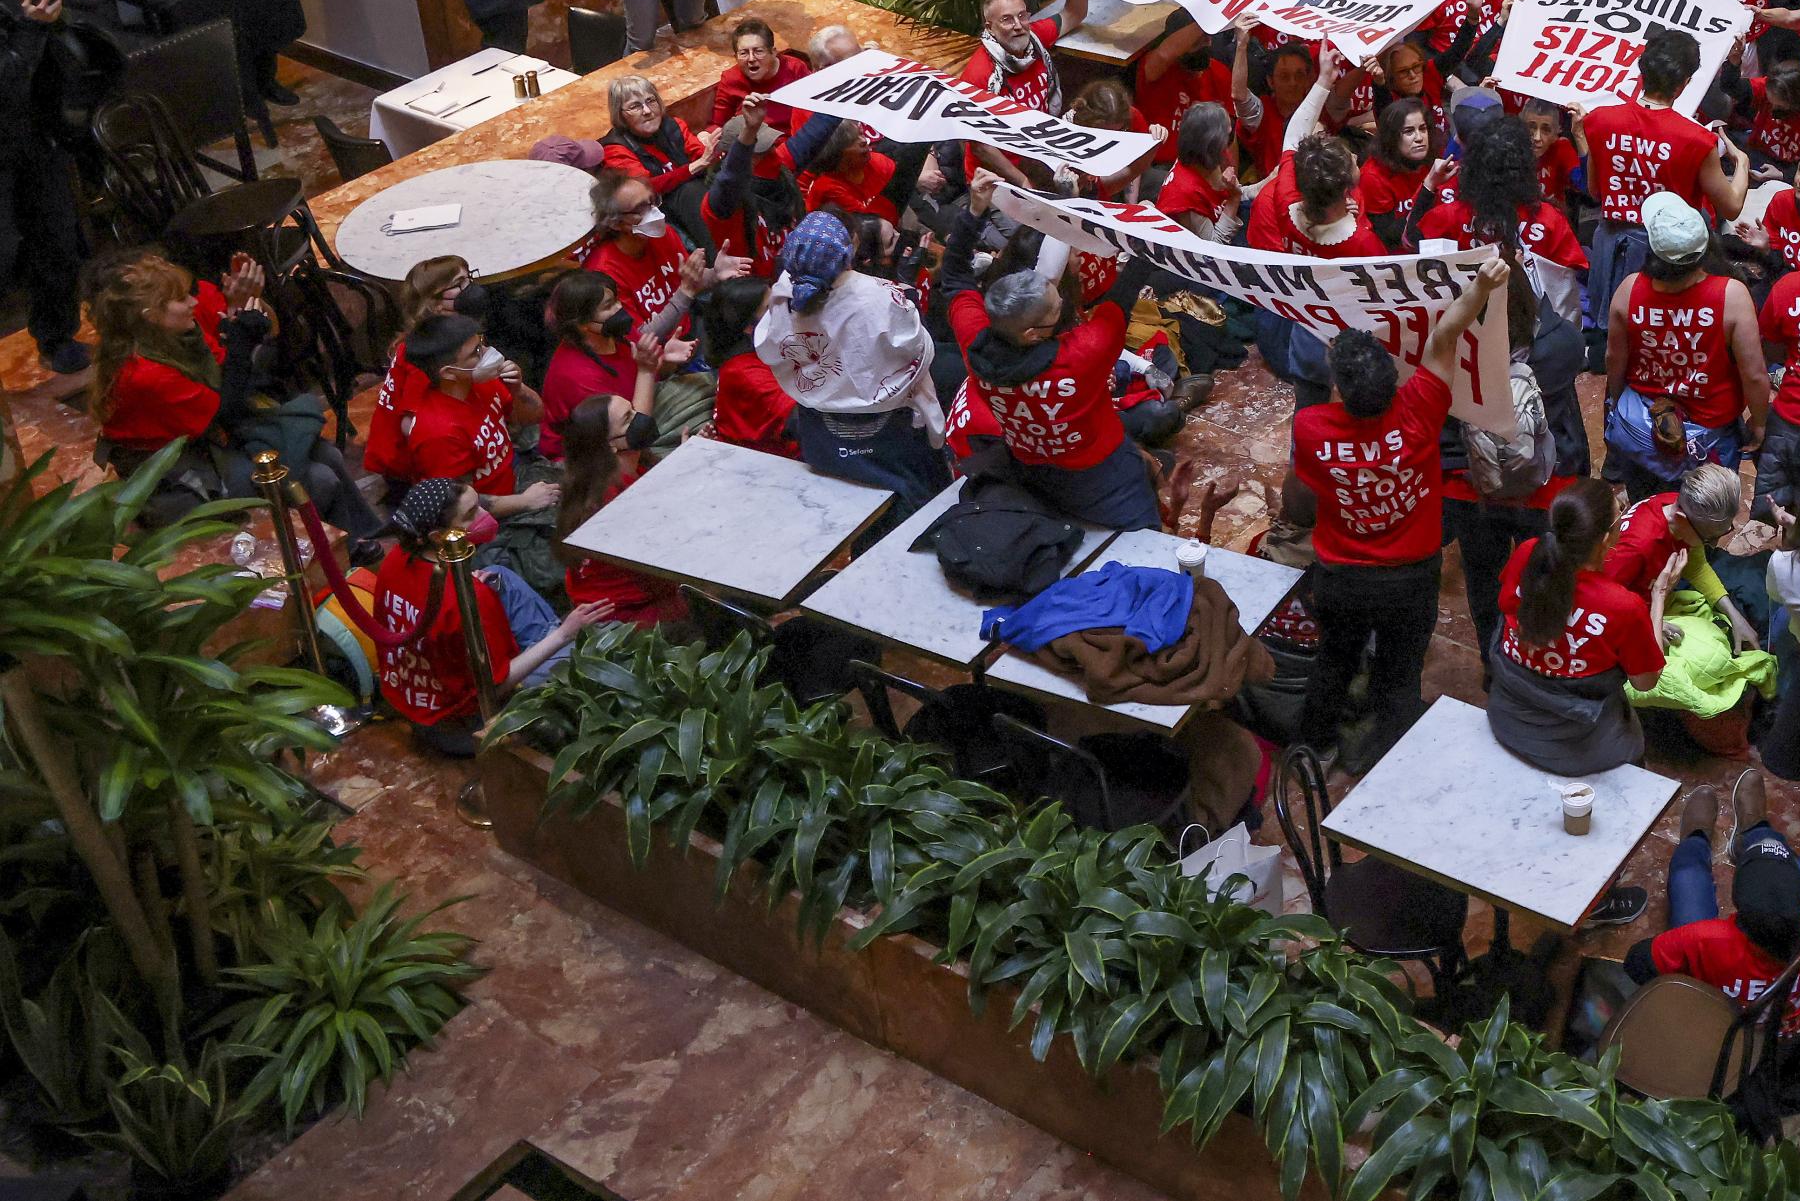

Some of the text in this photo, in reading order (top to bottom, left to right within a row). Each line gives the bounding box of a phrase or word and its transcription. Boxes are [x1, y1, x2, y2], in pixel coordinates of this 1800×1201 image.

[1533, 24, 1646, 69] AZIS
[810, 75, 951, 120] AGAIN
[1020, 119, 1121, 164] FOR
[1605, 133, 1672, 161] JEWS
[1611, 155, 1662, 179] SAY
[1631, 306, 1715, 328] JEWS
[1640, 330, 1704, 351] SAY
[991, 394, 1065, 423] SAY
[473, 415, 493, 451] NOT
[1316, 429, 1405, 463] JEWS
[1329, 456, 1401, 489] SAY
[1335, 468, 1414, 507] STOP
